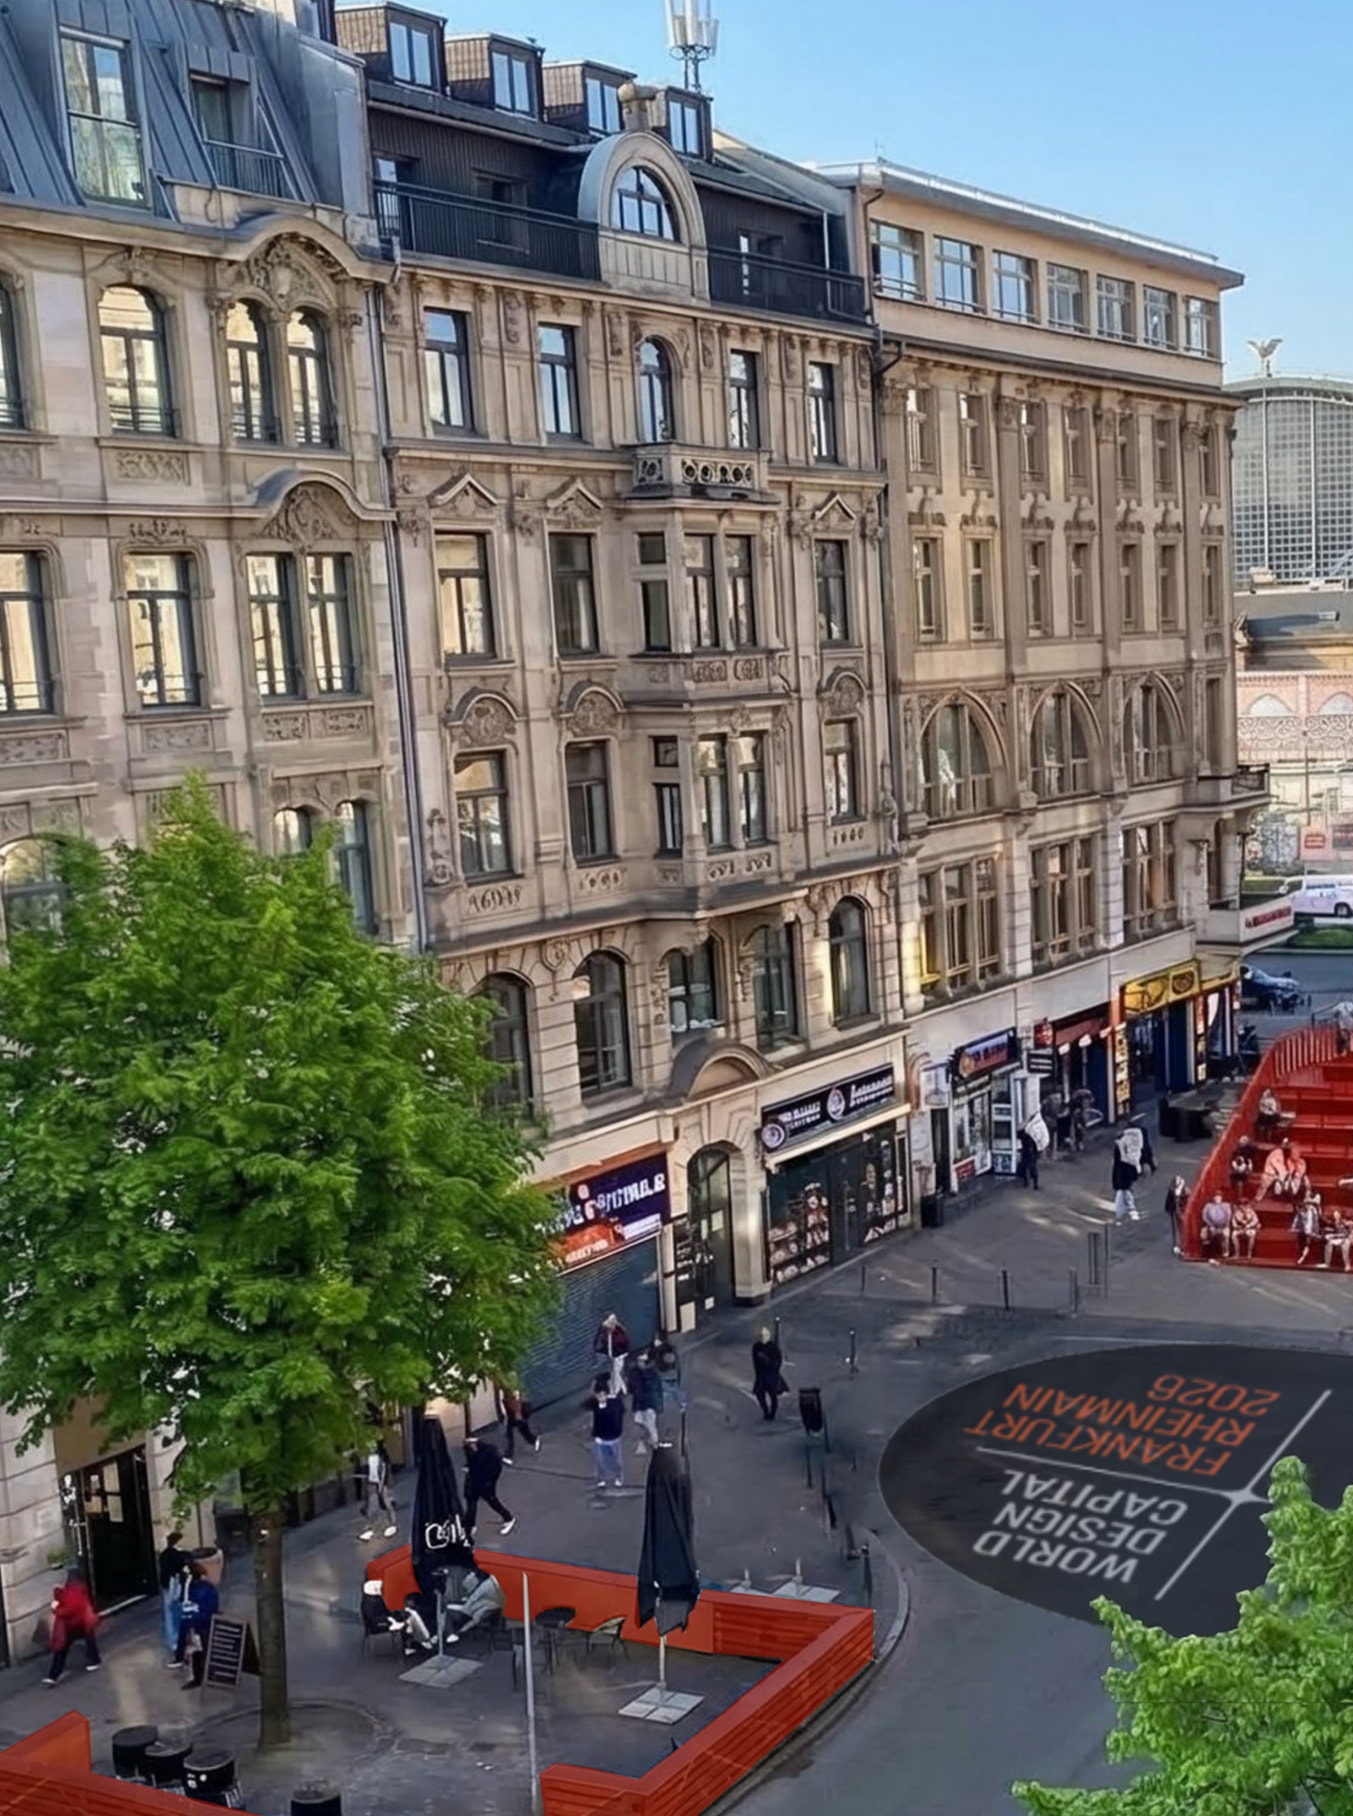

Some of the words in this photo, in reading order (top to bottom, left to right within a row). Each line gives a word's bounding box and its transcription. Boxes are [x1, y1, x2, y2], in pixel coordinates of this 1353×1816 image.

[1002, 1382, 1257, 1447] RHEINMAIN
[1147, 1373, 1280, 1417] 2026
[963, 1408, 1232, 1476] FRANKFURT
[1001, 1468, 1188, 1526] CAPITAL
[972, 1529, 1139, 1583] WORLD
[993, 1501, 1167, 1556] DESIGN
